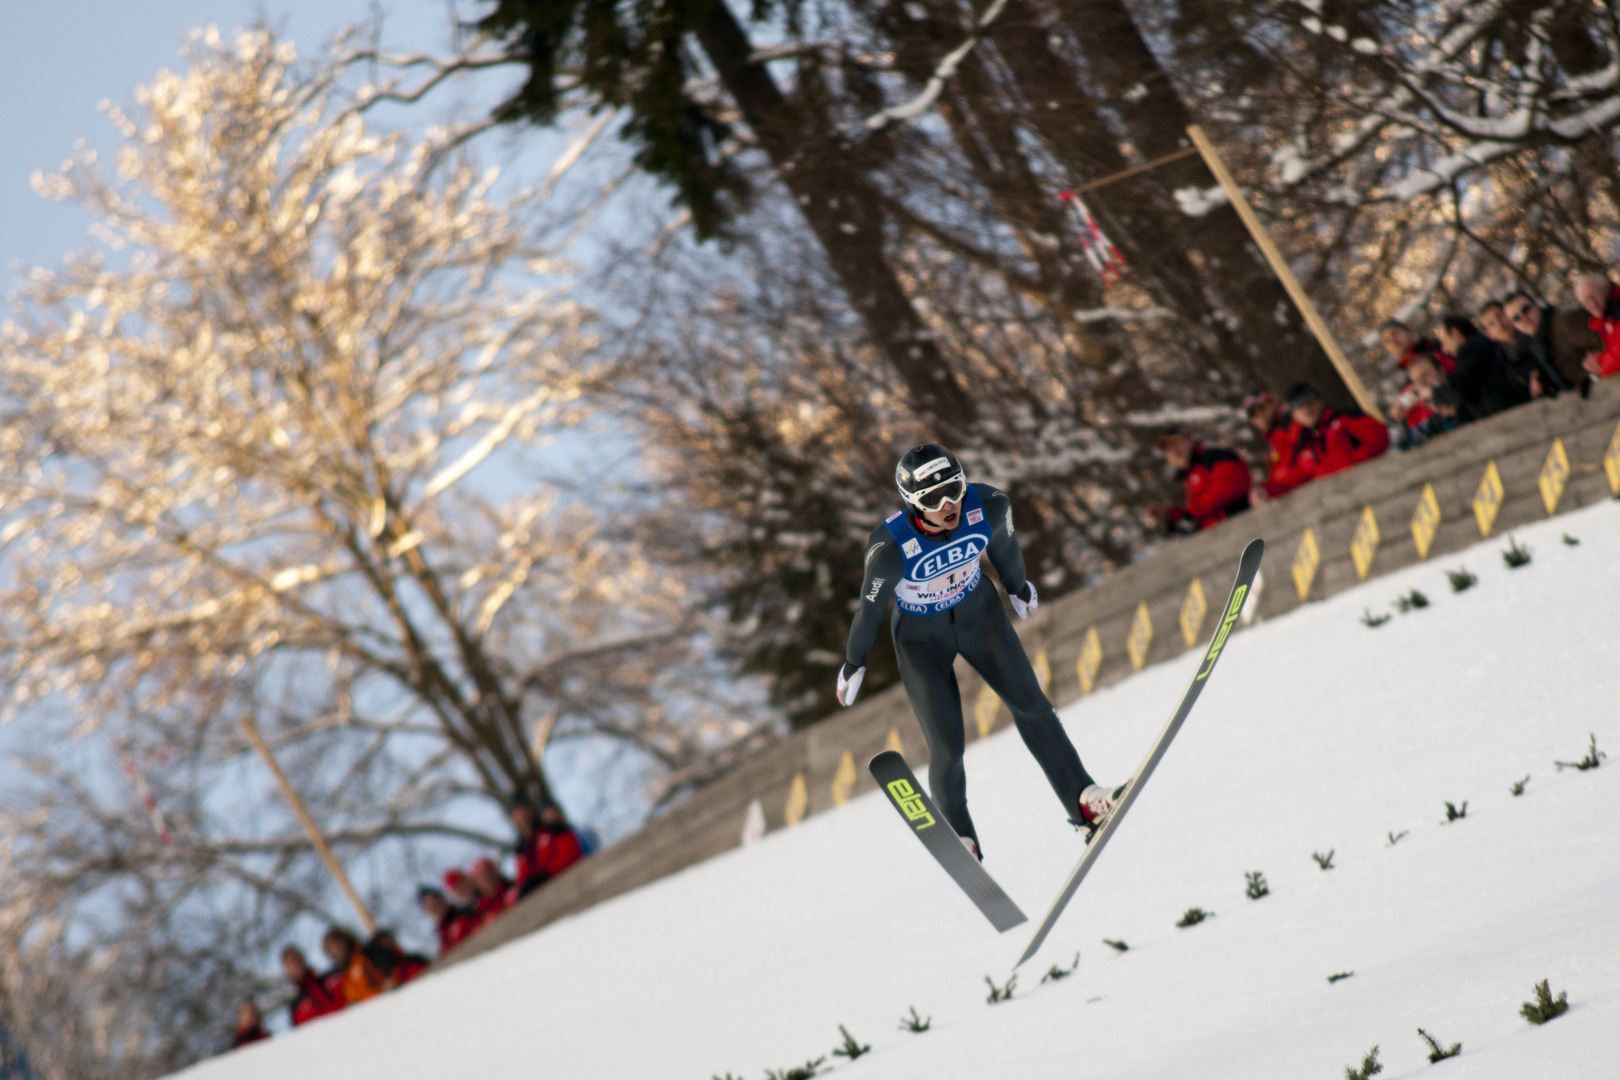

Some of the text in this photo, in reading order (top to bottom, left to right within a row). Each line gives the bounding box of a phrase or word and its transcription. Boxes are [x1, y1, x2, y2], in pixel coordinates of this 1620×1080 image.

[924, 542, 980, 577] ELBA
[865, 576, 885, 603] Audi
[946, 573, 956, 585] 1
[899, 601, 923, 613] ELBA
[940, 594, 962, 609] ELBA
[1196, 584, 1248, 681] elan
[886, 778, 936, 831] elan
